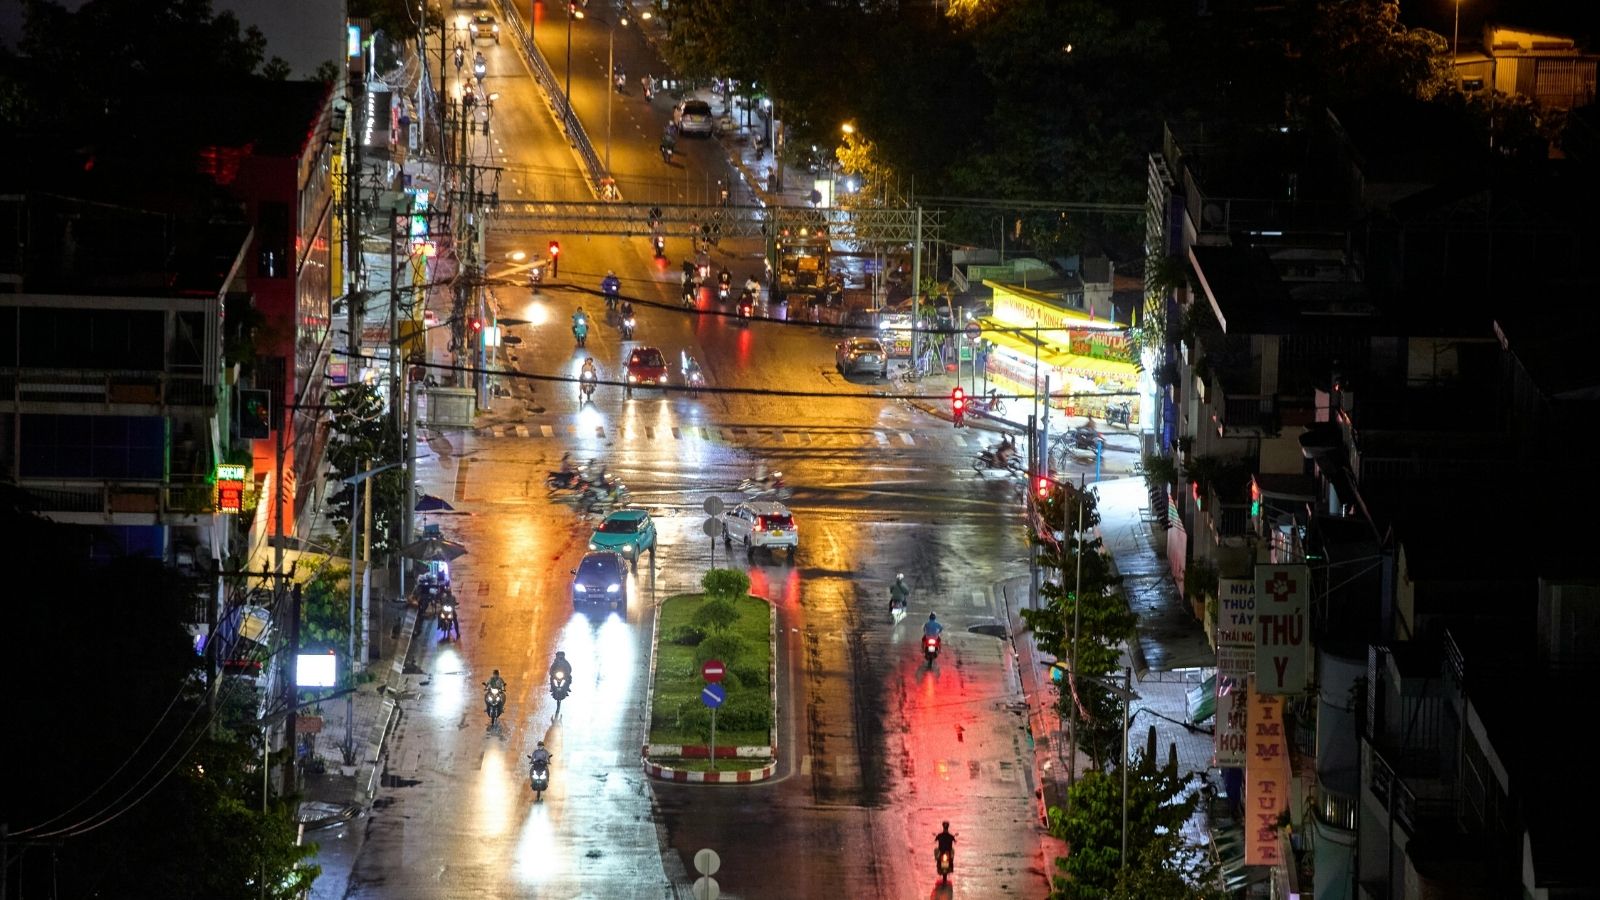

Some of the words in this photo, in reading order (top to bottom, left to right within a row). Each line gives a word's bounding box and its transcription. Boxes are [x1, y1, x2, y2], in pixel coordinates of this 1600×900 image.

[1231, 612, 1255, 625] TÂY
[1259, 608, 1303, 646] THÚ
[1273, 656, 1288, 688] Y
